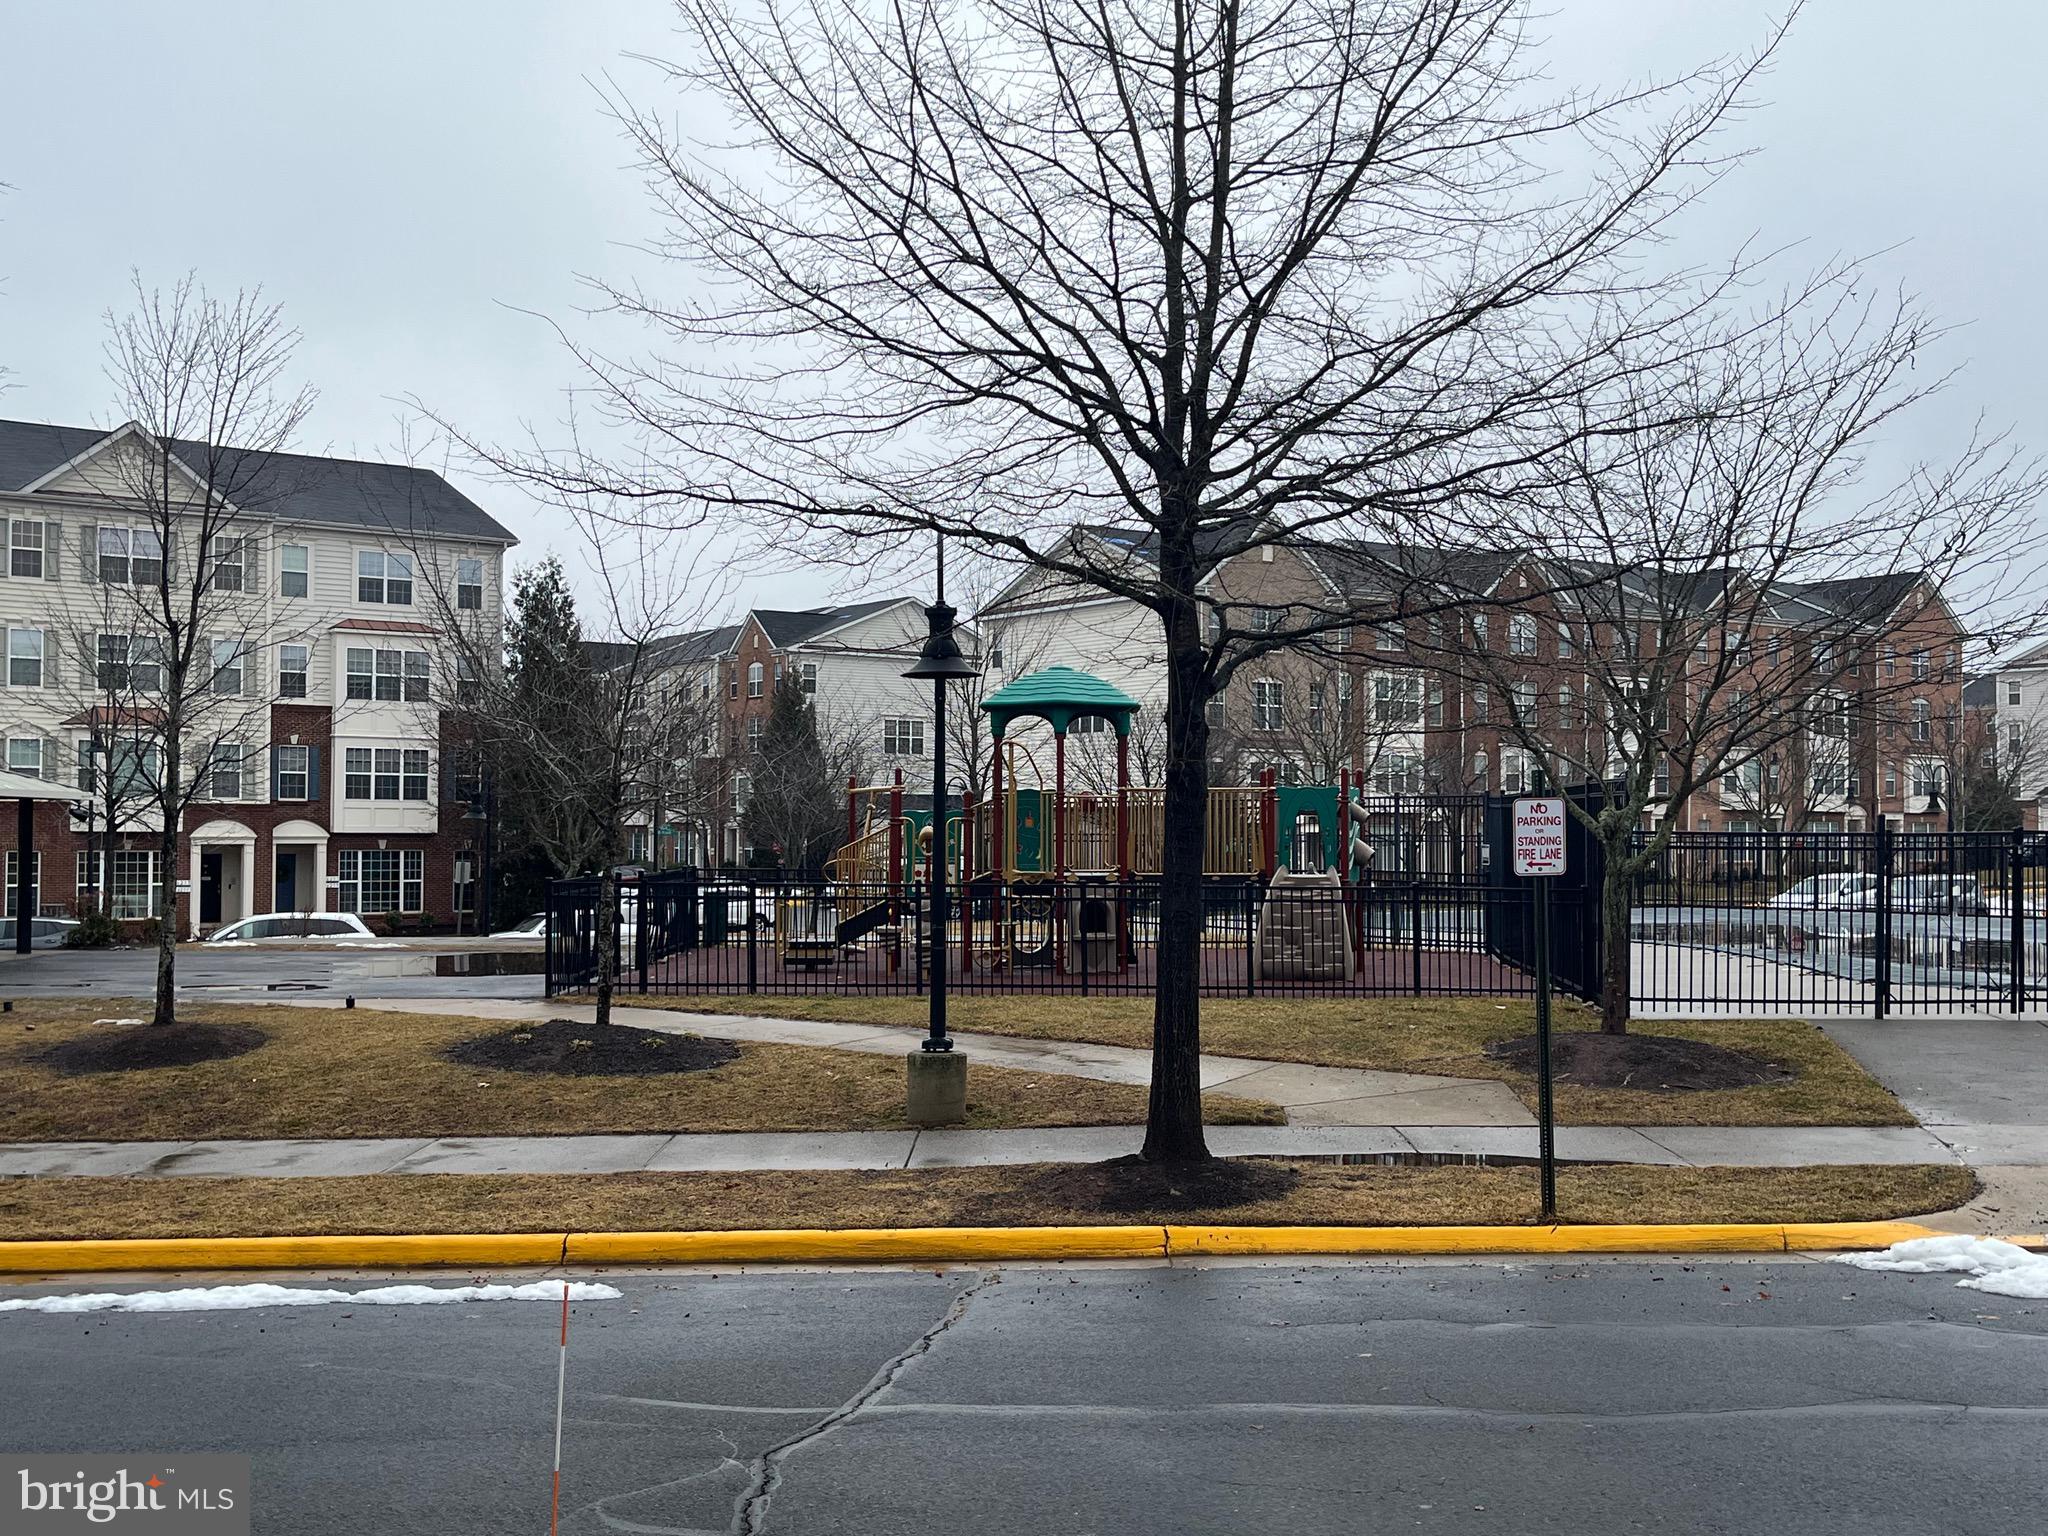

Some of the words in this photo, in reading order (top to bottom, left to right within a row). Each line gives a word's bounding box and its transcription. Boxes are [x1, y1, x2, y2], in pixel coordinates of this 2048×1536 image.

[1530, 804, 1548, 814] NO
[1517, 816, 1561, 826] PARKING
[1517, 836, 1562, 846] STANDING
[1518, 849, 1536, 860] FIRE
[1540, 848, 1562, 860] LANE
